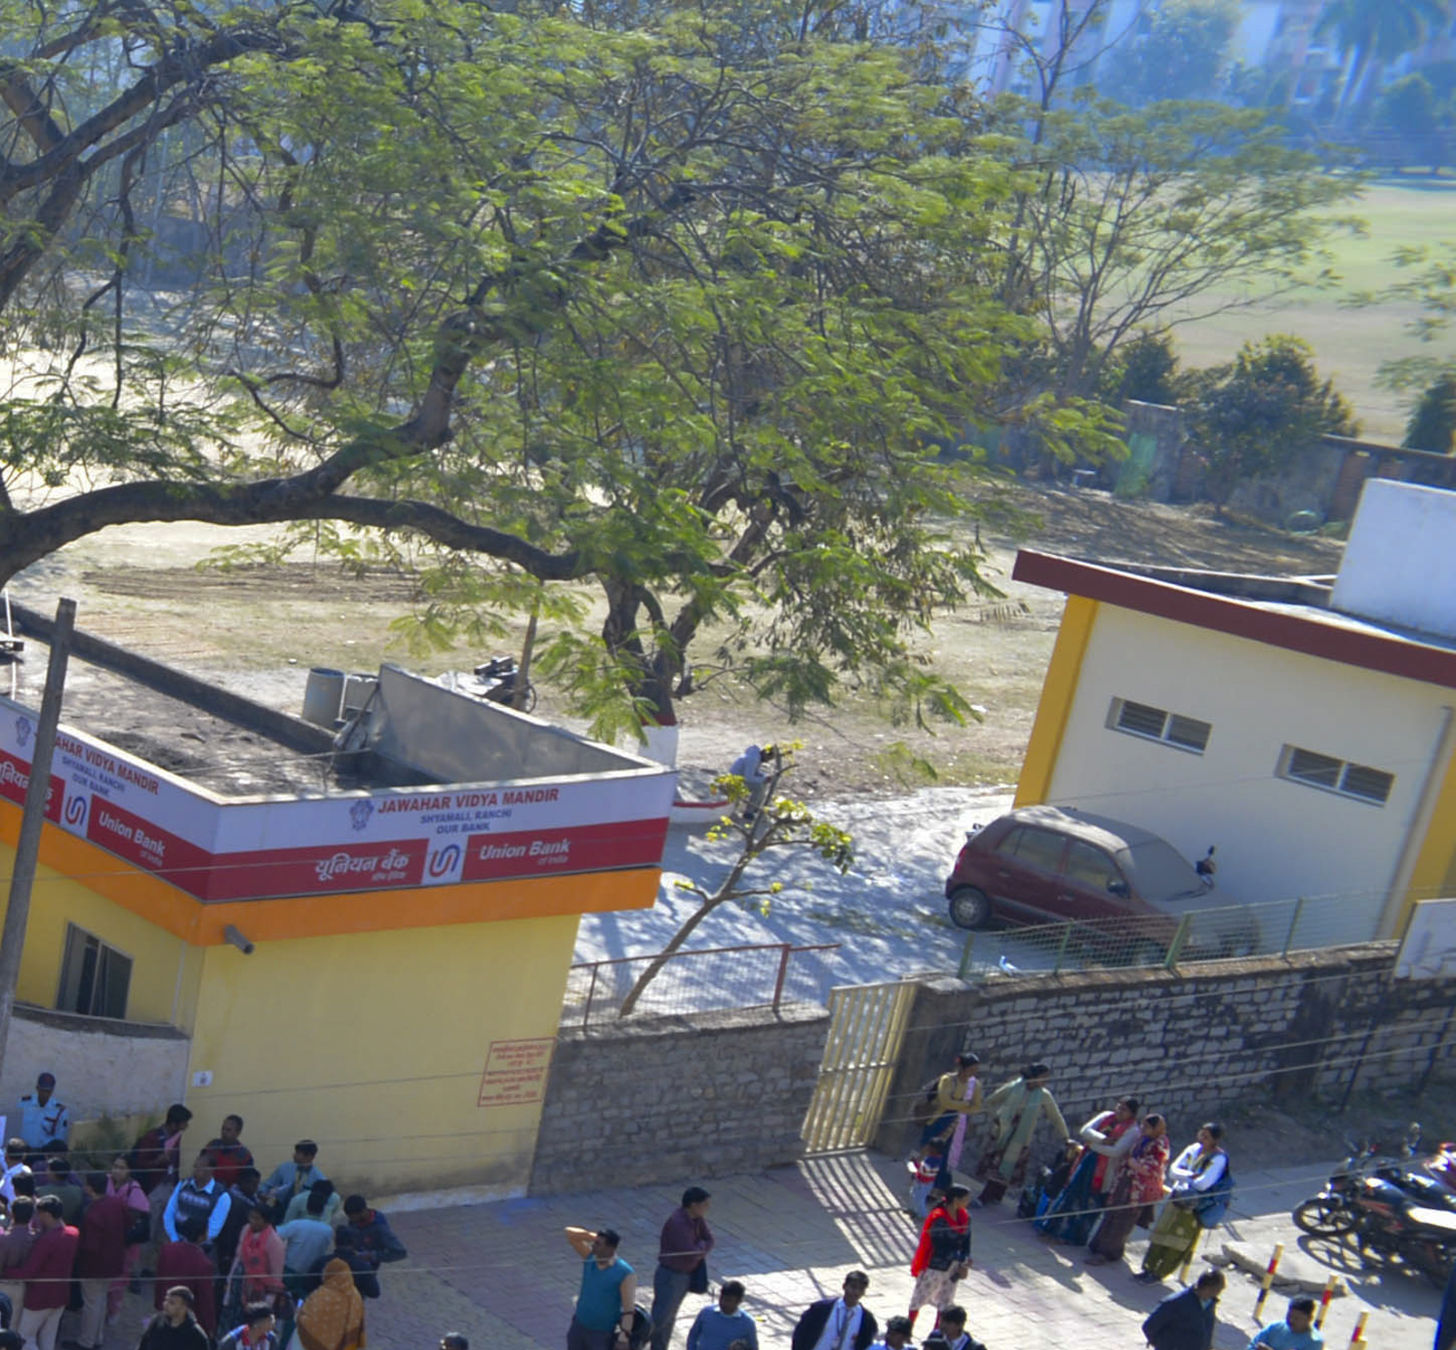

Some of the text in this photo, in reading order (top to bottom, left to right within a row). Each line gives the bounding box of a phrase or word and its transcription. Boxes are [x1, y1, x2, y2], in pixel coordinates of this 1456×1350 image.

[55, 735, 159, 795] AHAR VIDYA MANDIR
[378, 788, 559, 814] JAWAHAR VIDYA MANDIR
[475, 809, 512, 821] RANCHI
[99, 811, 166, 856] Union Bank
[436, 822, 490, 835] OUR BANK
[480, 838, 571, 861] Union Bank
[315, 848, 409, 882] यूनियन बैंक
